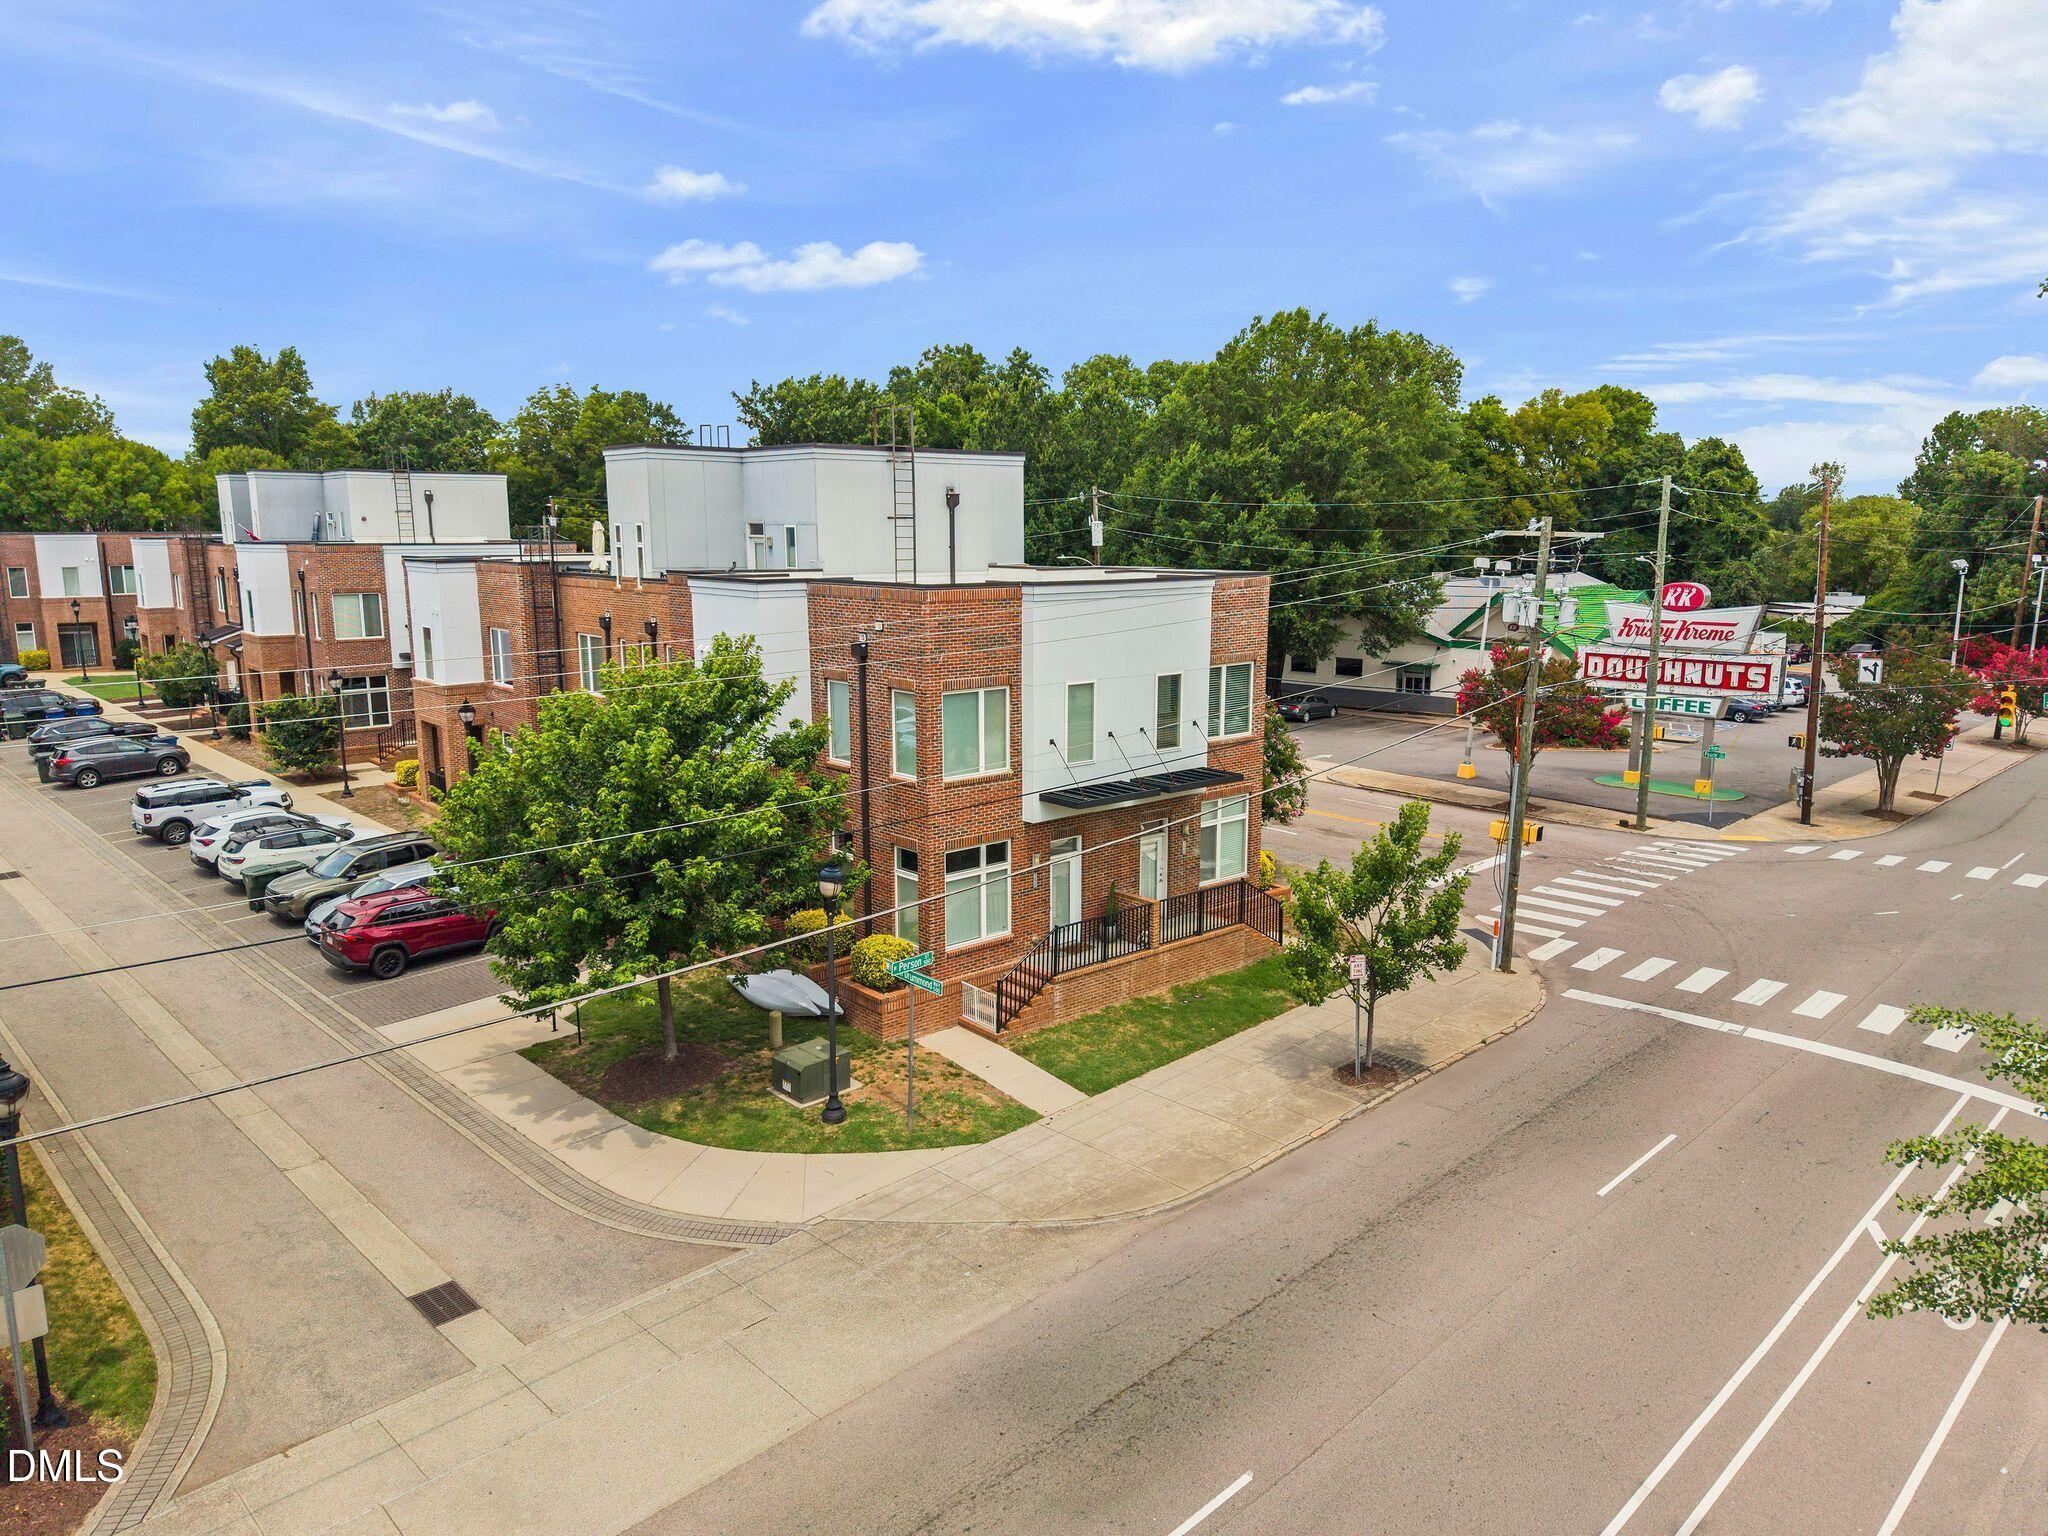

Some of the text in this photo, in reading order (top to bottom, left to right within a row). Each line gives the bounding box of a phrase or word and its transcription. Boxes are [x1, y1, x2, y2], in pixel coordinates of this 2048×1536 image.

[1663, 587, 1696, 607] KK
[1674, 619, 1740, 642] Kreme
[1631, 697, 1711, 715] CFFEE
[899, 958, 922, 972] Person
